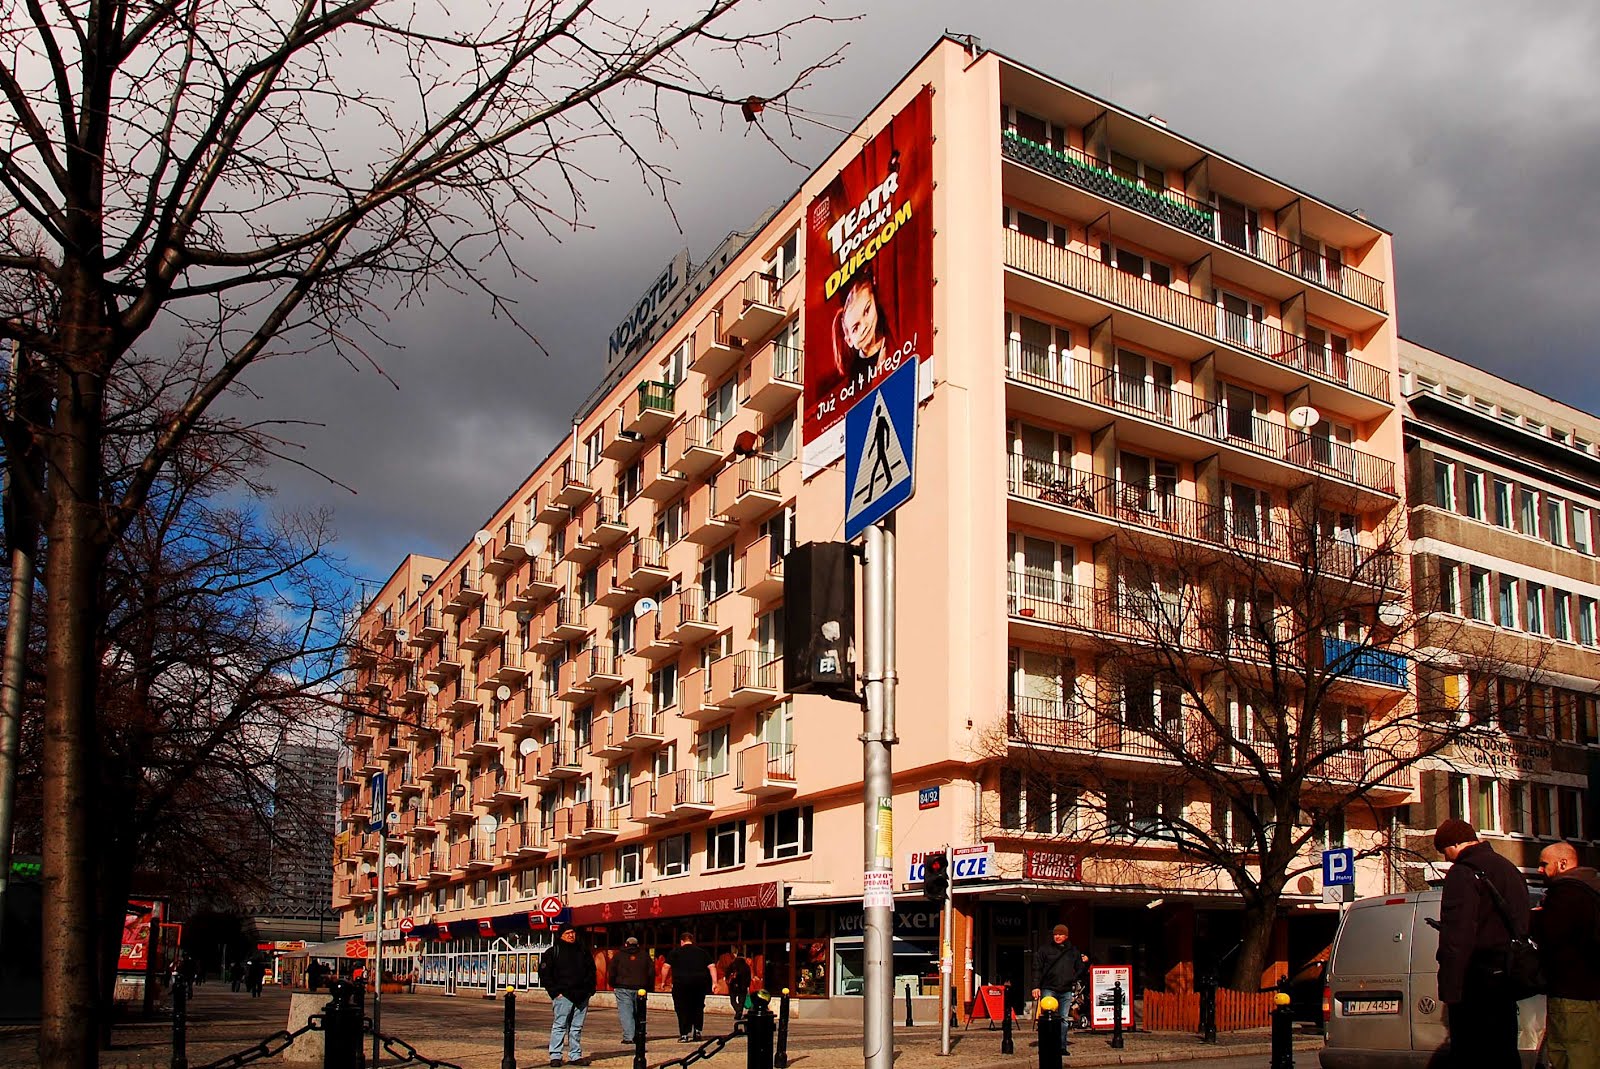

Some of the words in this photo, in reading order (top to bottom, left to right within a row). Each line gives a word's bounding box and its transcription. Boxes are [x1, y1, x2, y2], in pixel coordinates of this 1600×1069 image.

[827, 171, 899, 254] TEATR
[838, 202, 892, 265] POLSKI
[825, 200, 912, 300] DZIECIOM
[608, 262, 678, 364] NOVOTEL
[840, 380, 855, 401] od
[858, 373, 865, 390] 4
[1484, 739, 1497, 750] DO
[909, 857, 987, 881] LOICZE
[1329, 852, 1347, 881] P
